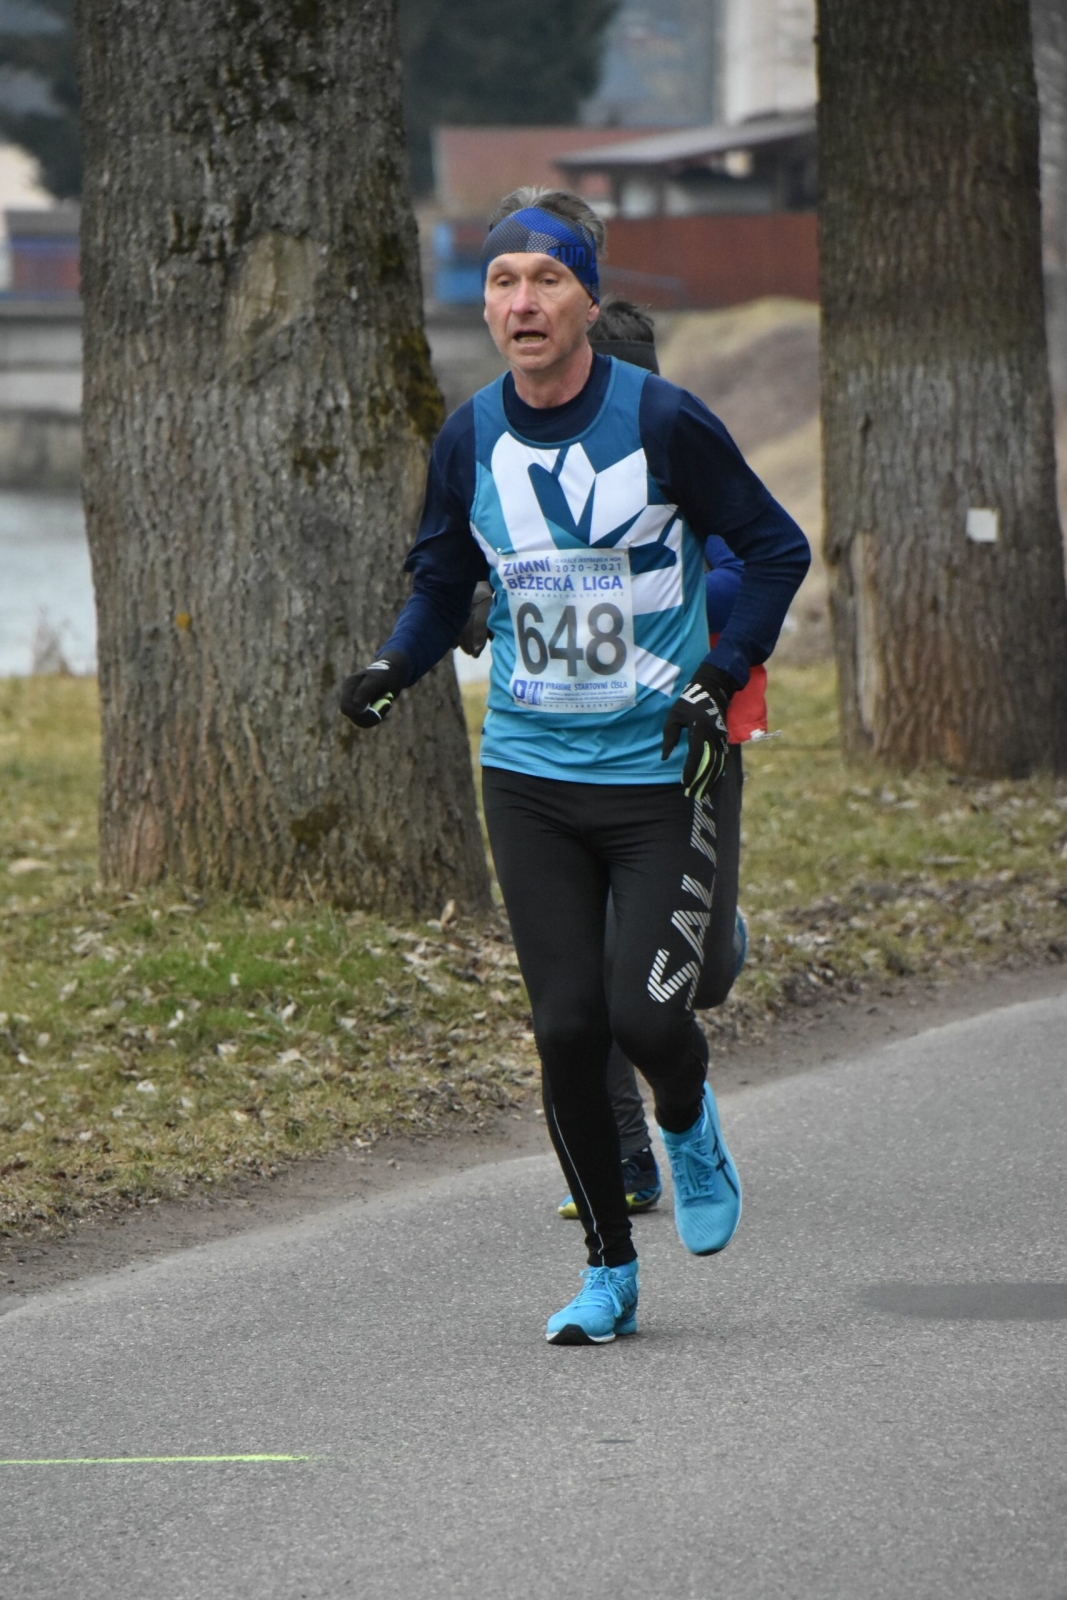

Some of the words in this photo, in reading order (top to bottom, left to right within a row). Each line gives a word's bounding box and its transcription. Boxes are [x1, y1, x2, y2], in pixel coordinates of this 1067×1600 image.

[503, 557, 551, 576] ZIMNÍ
[506, 574, 574, 591] BĚŽECKÁ
[583, 575, 623, 591] LIGA
[516, 602, 627, 677] 648
